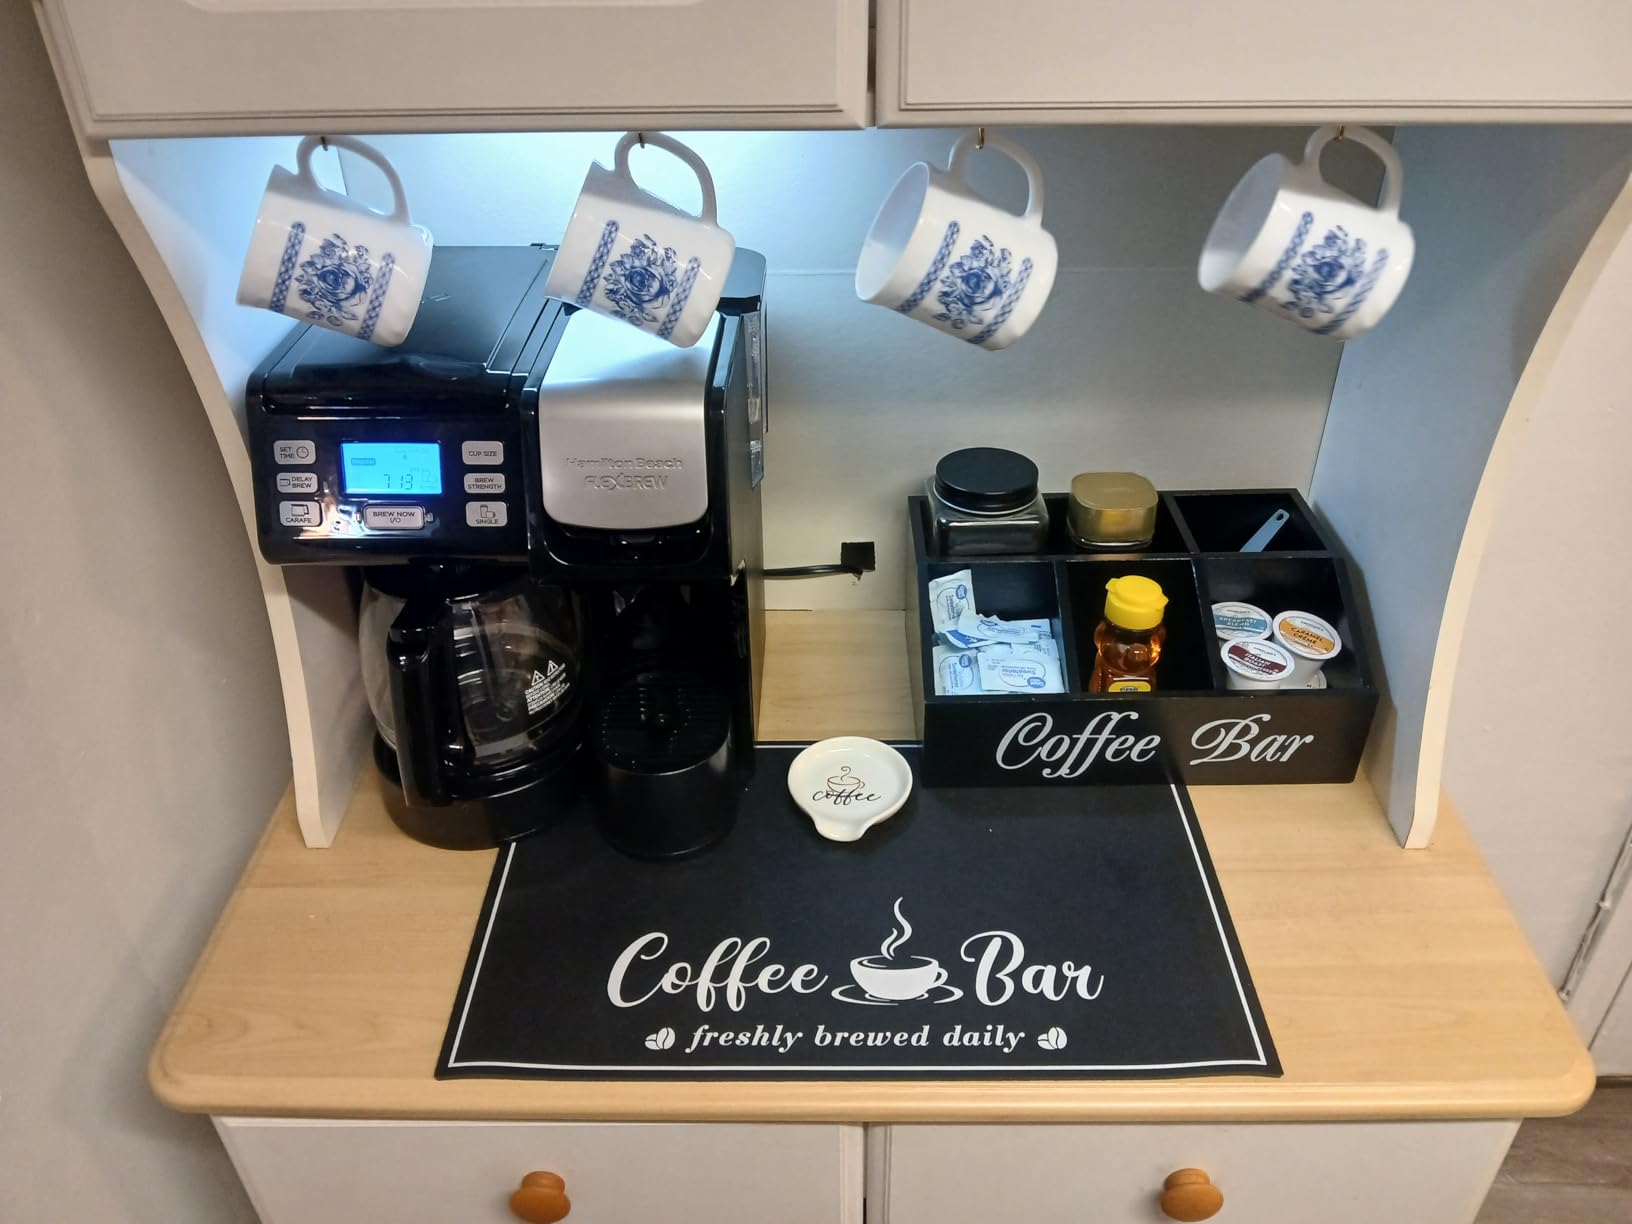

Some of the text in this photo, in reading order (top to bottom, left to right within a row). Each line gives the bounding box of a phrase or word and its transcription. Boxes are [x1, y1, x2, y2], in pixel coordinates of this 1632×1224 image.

[636, 457, 683, 470] Beach
[1291, 627, 1323, 641] CARAMEL
[1244, 653, 1271, 665] ITALIAN
[995, 711, 1314, 778] Coffee Bar
[812, 789, 881, 805] coffee
[606, 930, 1105, 1013] Coffee Bar
[684, 1024, 1025, 1053] freshly brewed daily
